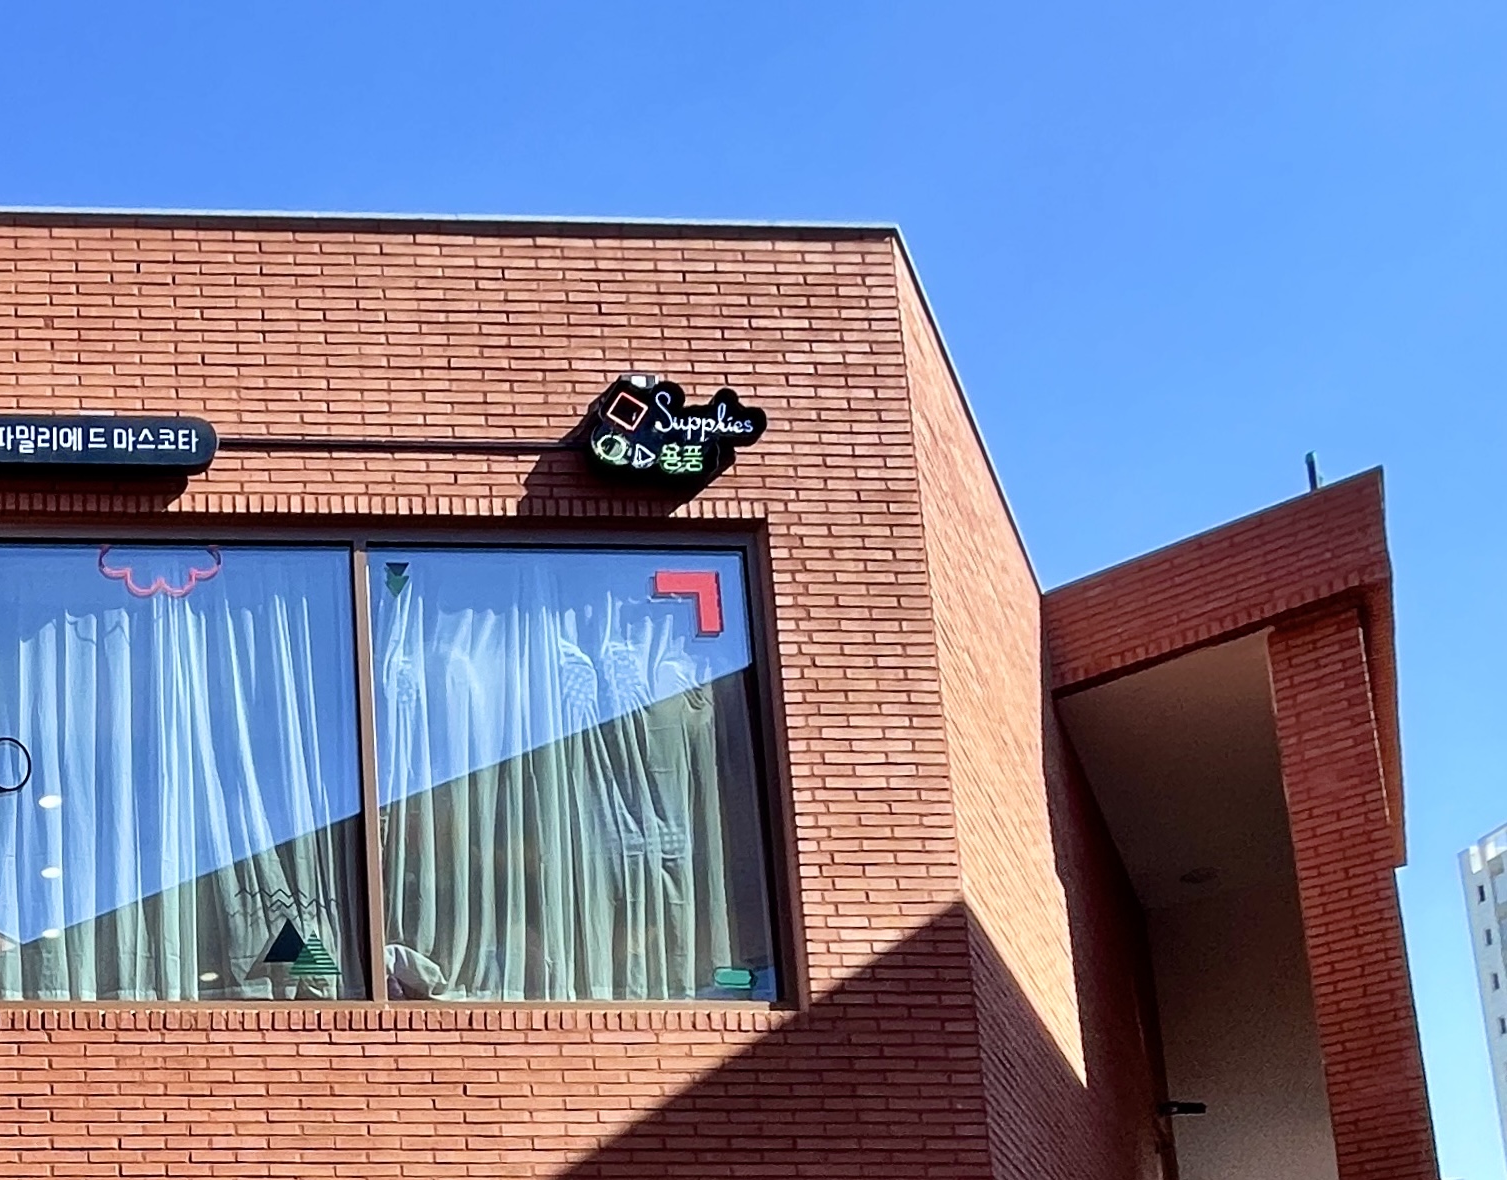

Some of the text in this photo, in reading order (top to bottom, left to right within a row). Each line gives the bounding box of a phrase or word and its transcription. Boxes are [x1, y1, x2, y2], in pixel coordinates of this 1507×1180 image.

[655, 391, 754, 442] Supplies
[113, 428, 199, 453] 마스코타
[661, 444, 704, 472] 용품
